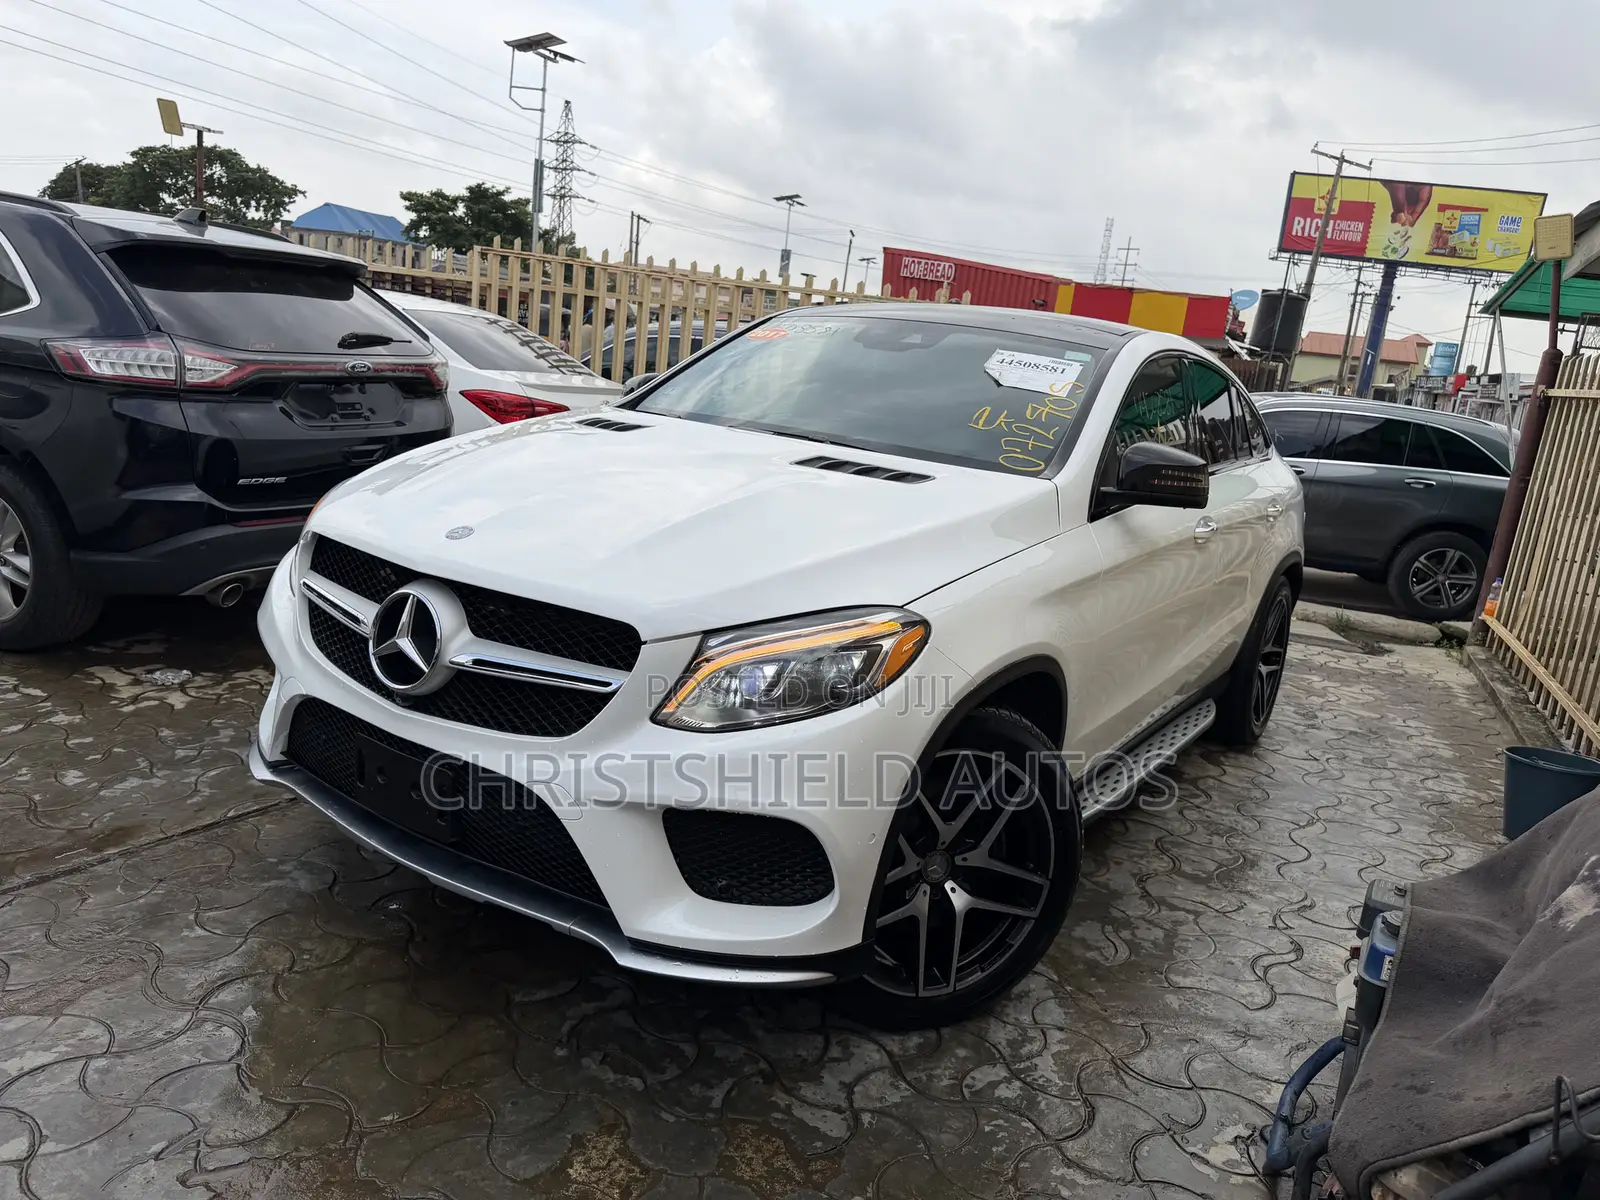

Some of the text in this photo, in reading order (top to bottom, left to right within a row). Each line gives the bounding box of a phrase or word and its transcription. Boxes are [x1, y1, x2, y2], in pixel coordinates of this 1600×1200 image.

[1335, 219, 1364, 232] CHICKEN
[1332, 229, 1362, 242] FLAVOUR
[996, 357, 1067, 374] 44508581
[237, 476, 288, 485] EDGE
